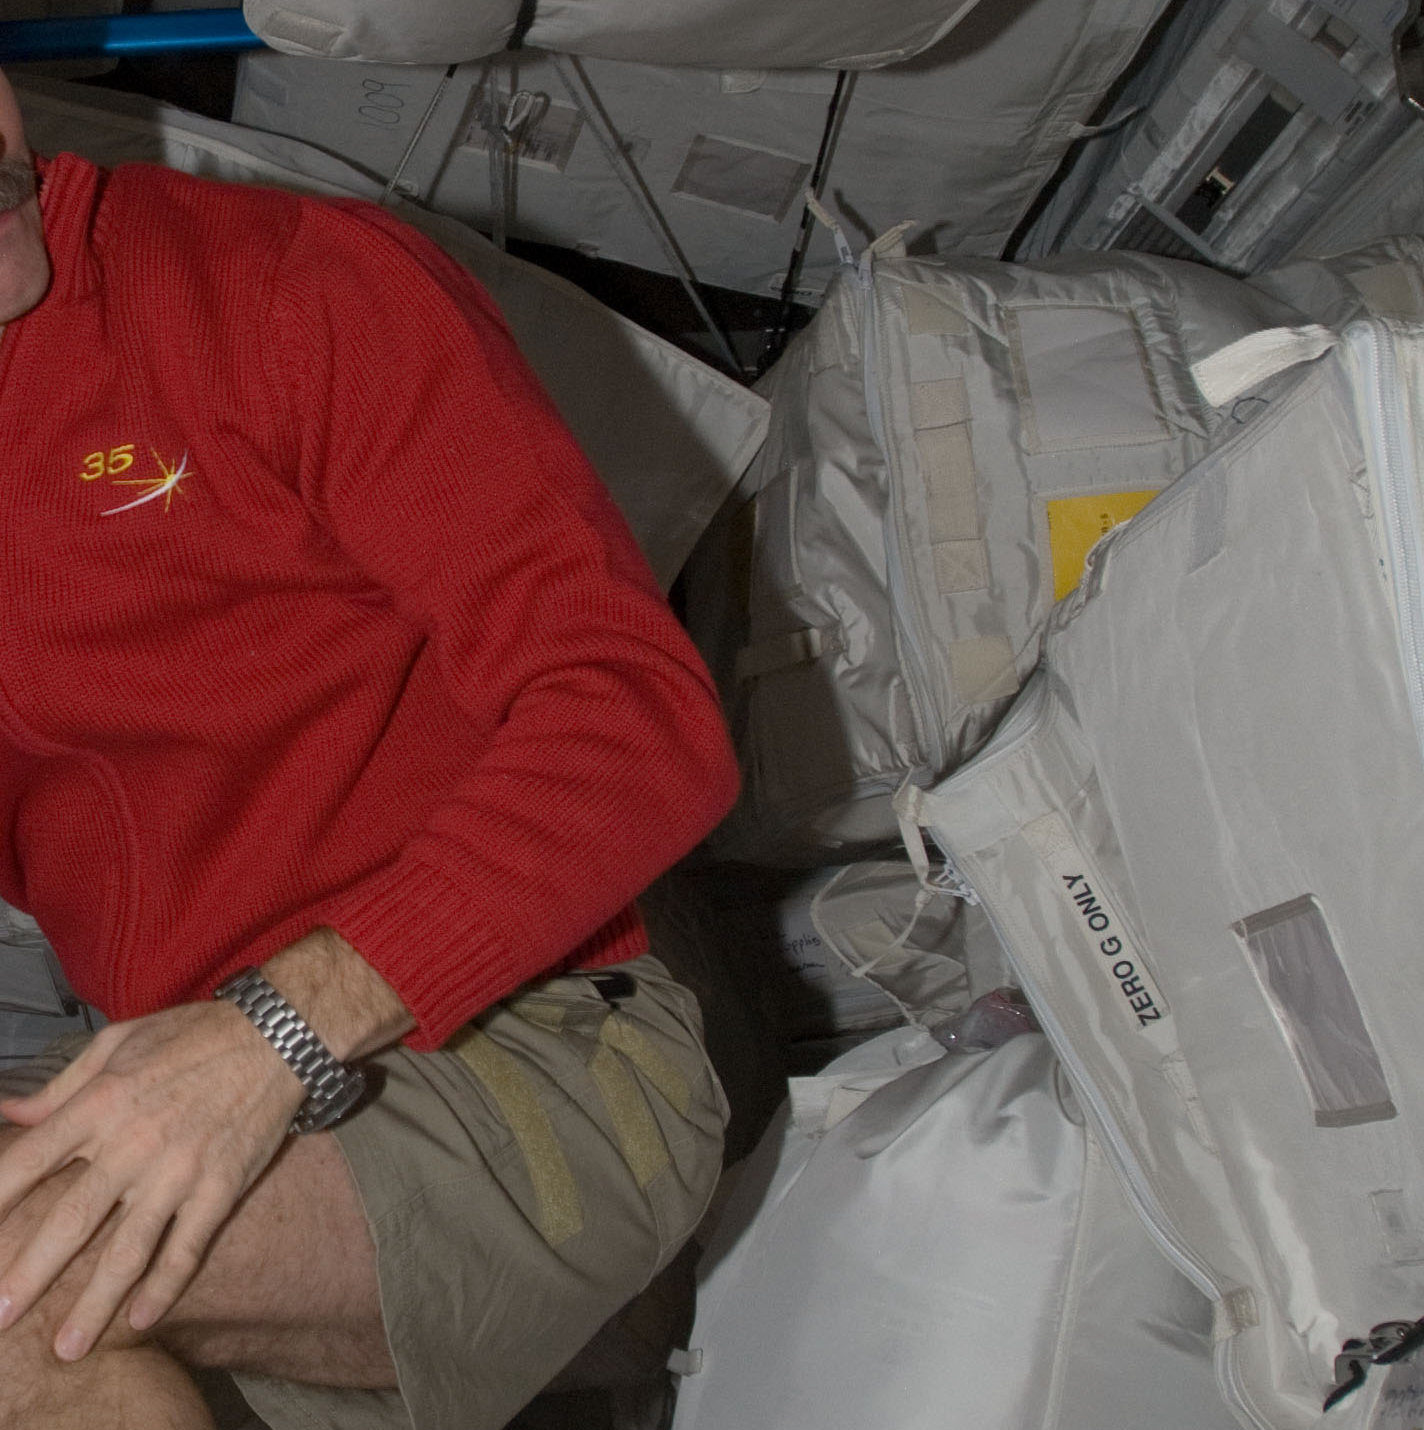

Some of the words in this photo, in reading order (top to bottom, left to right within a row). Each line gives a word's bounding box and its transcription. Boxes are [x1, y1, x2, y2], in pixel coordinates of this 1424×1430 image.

[355, 76, 409, 129] 1009
[78, 444, 136, 482] 35
[1061, 871, 1112, 937] ONLY
[1101, 932, 1127, 958] G
[1108, 957, 1165, 1028] ZERO
